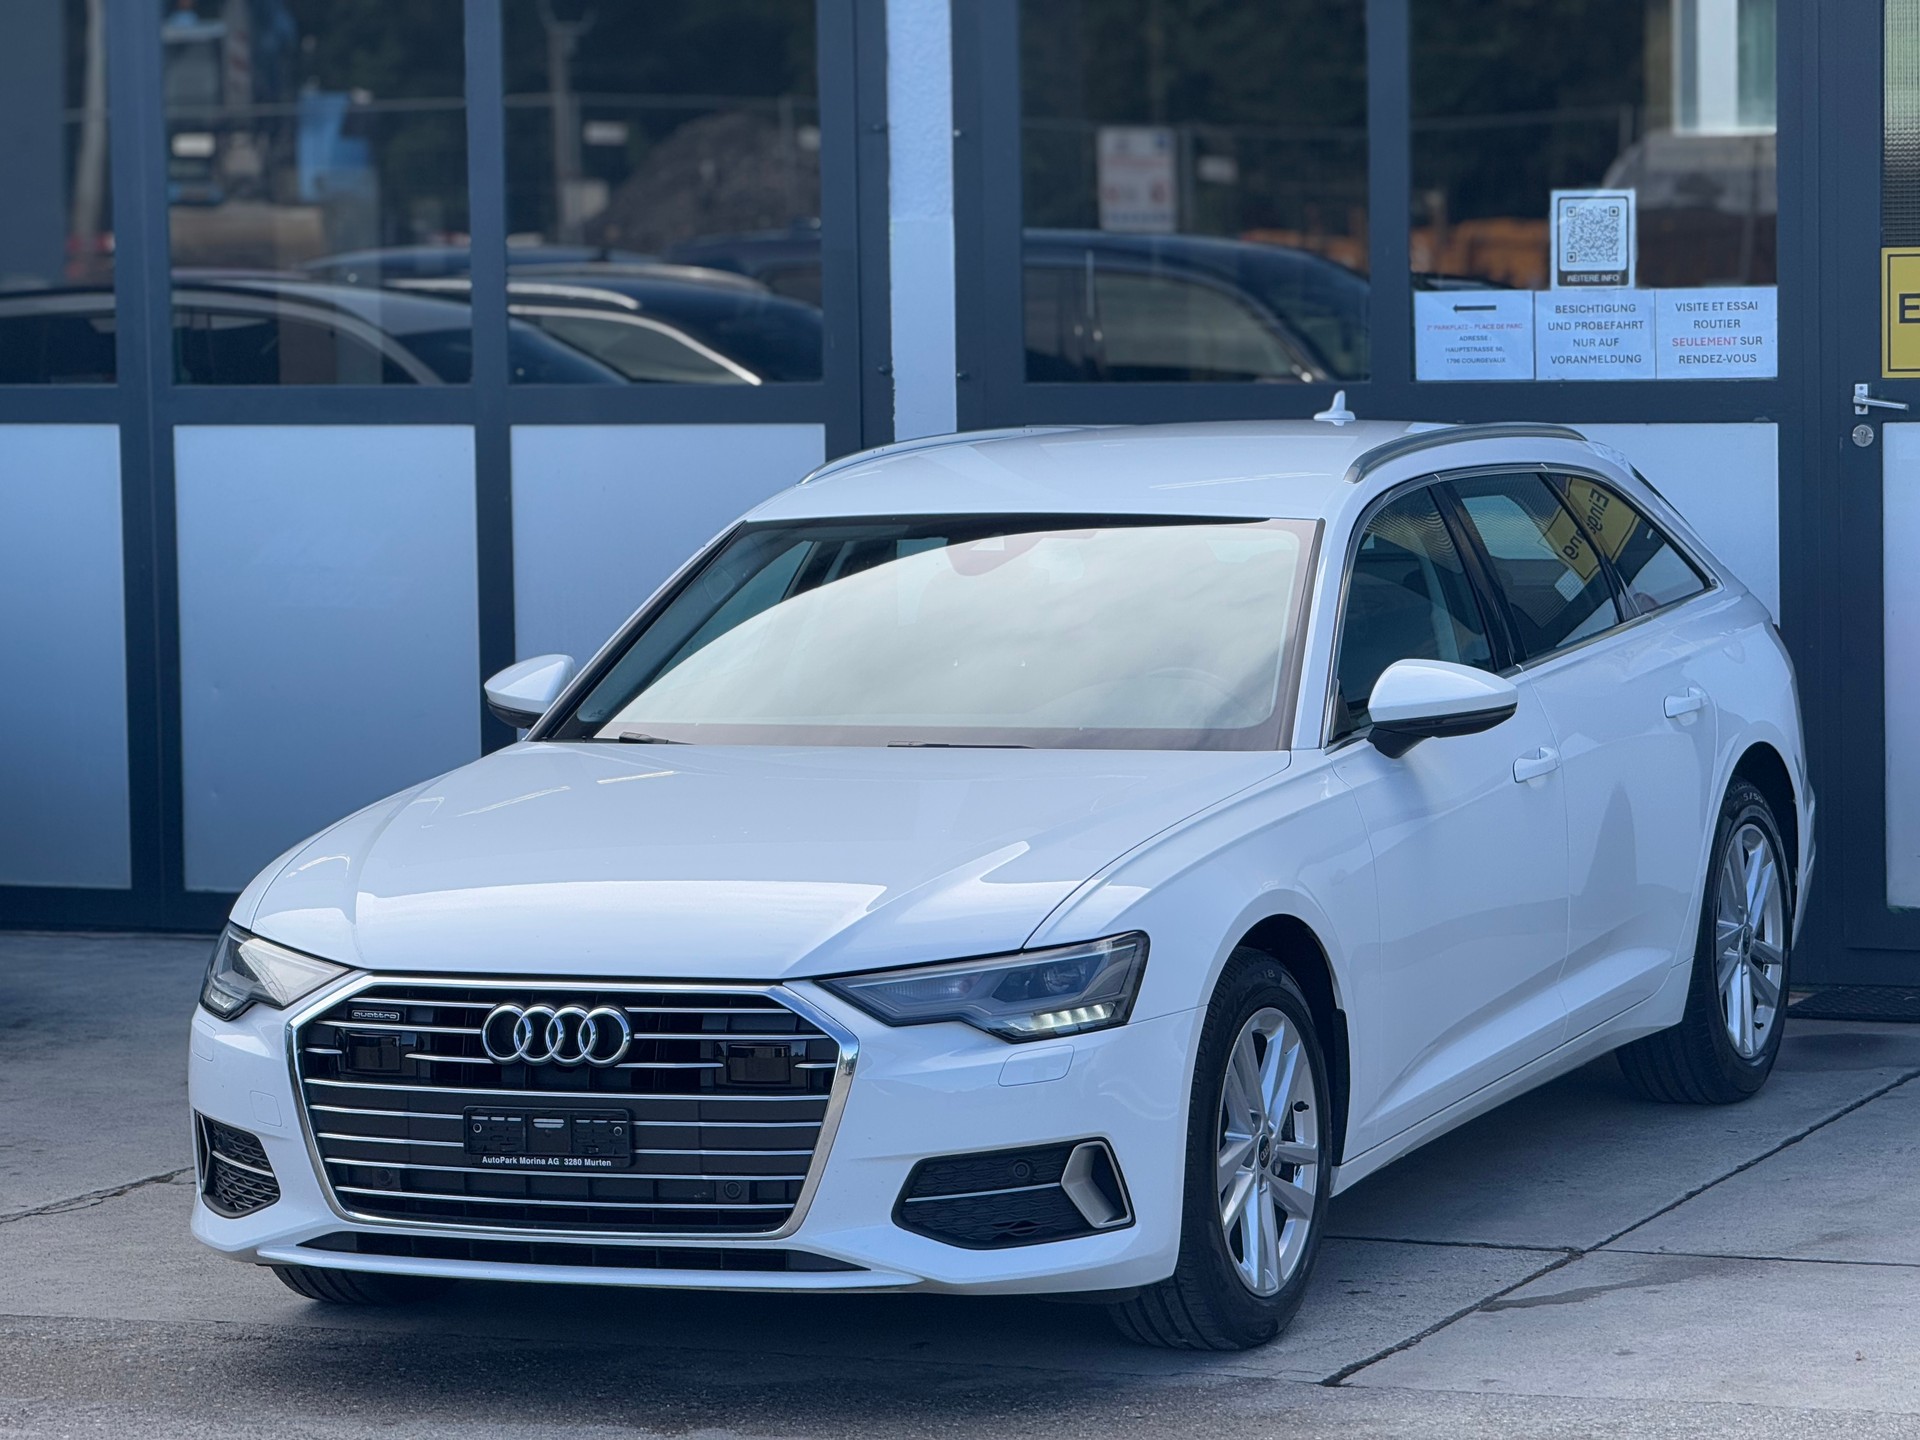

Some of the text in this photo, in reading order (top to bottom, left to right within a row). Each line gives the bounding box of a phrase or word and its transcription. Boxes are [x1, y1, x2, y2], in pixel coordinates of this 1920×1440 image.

[1601, 273, 1620, 282] INFO
[1555, 304, 1636, 314] BESICHTIGUNG
[1675, 301, 1758, 312] VISITE ET ESSAI
[1548, 320, 1644, 331] UND PROBEFAHRT
[1693, 319, 1741, 329] ROUTIER
[1573, 337, 1620, 348] NUR AUF
[1672, 336, 1763, 347] SEULEMENT SUR
[1550, 354, 1642, 365] VORANMELDUNG
[1678, 354, 1757, 364] RENDEZ-VOUS
[353, 1011, 397, 1020] quattro
[482, 1156, 612, 1167] AutoPark Morina AG 3280 Murten
